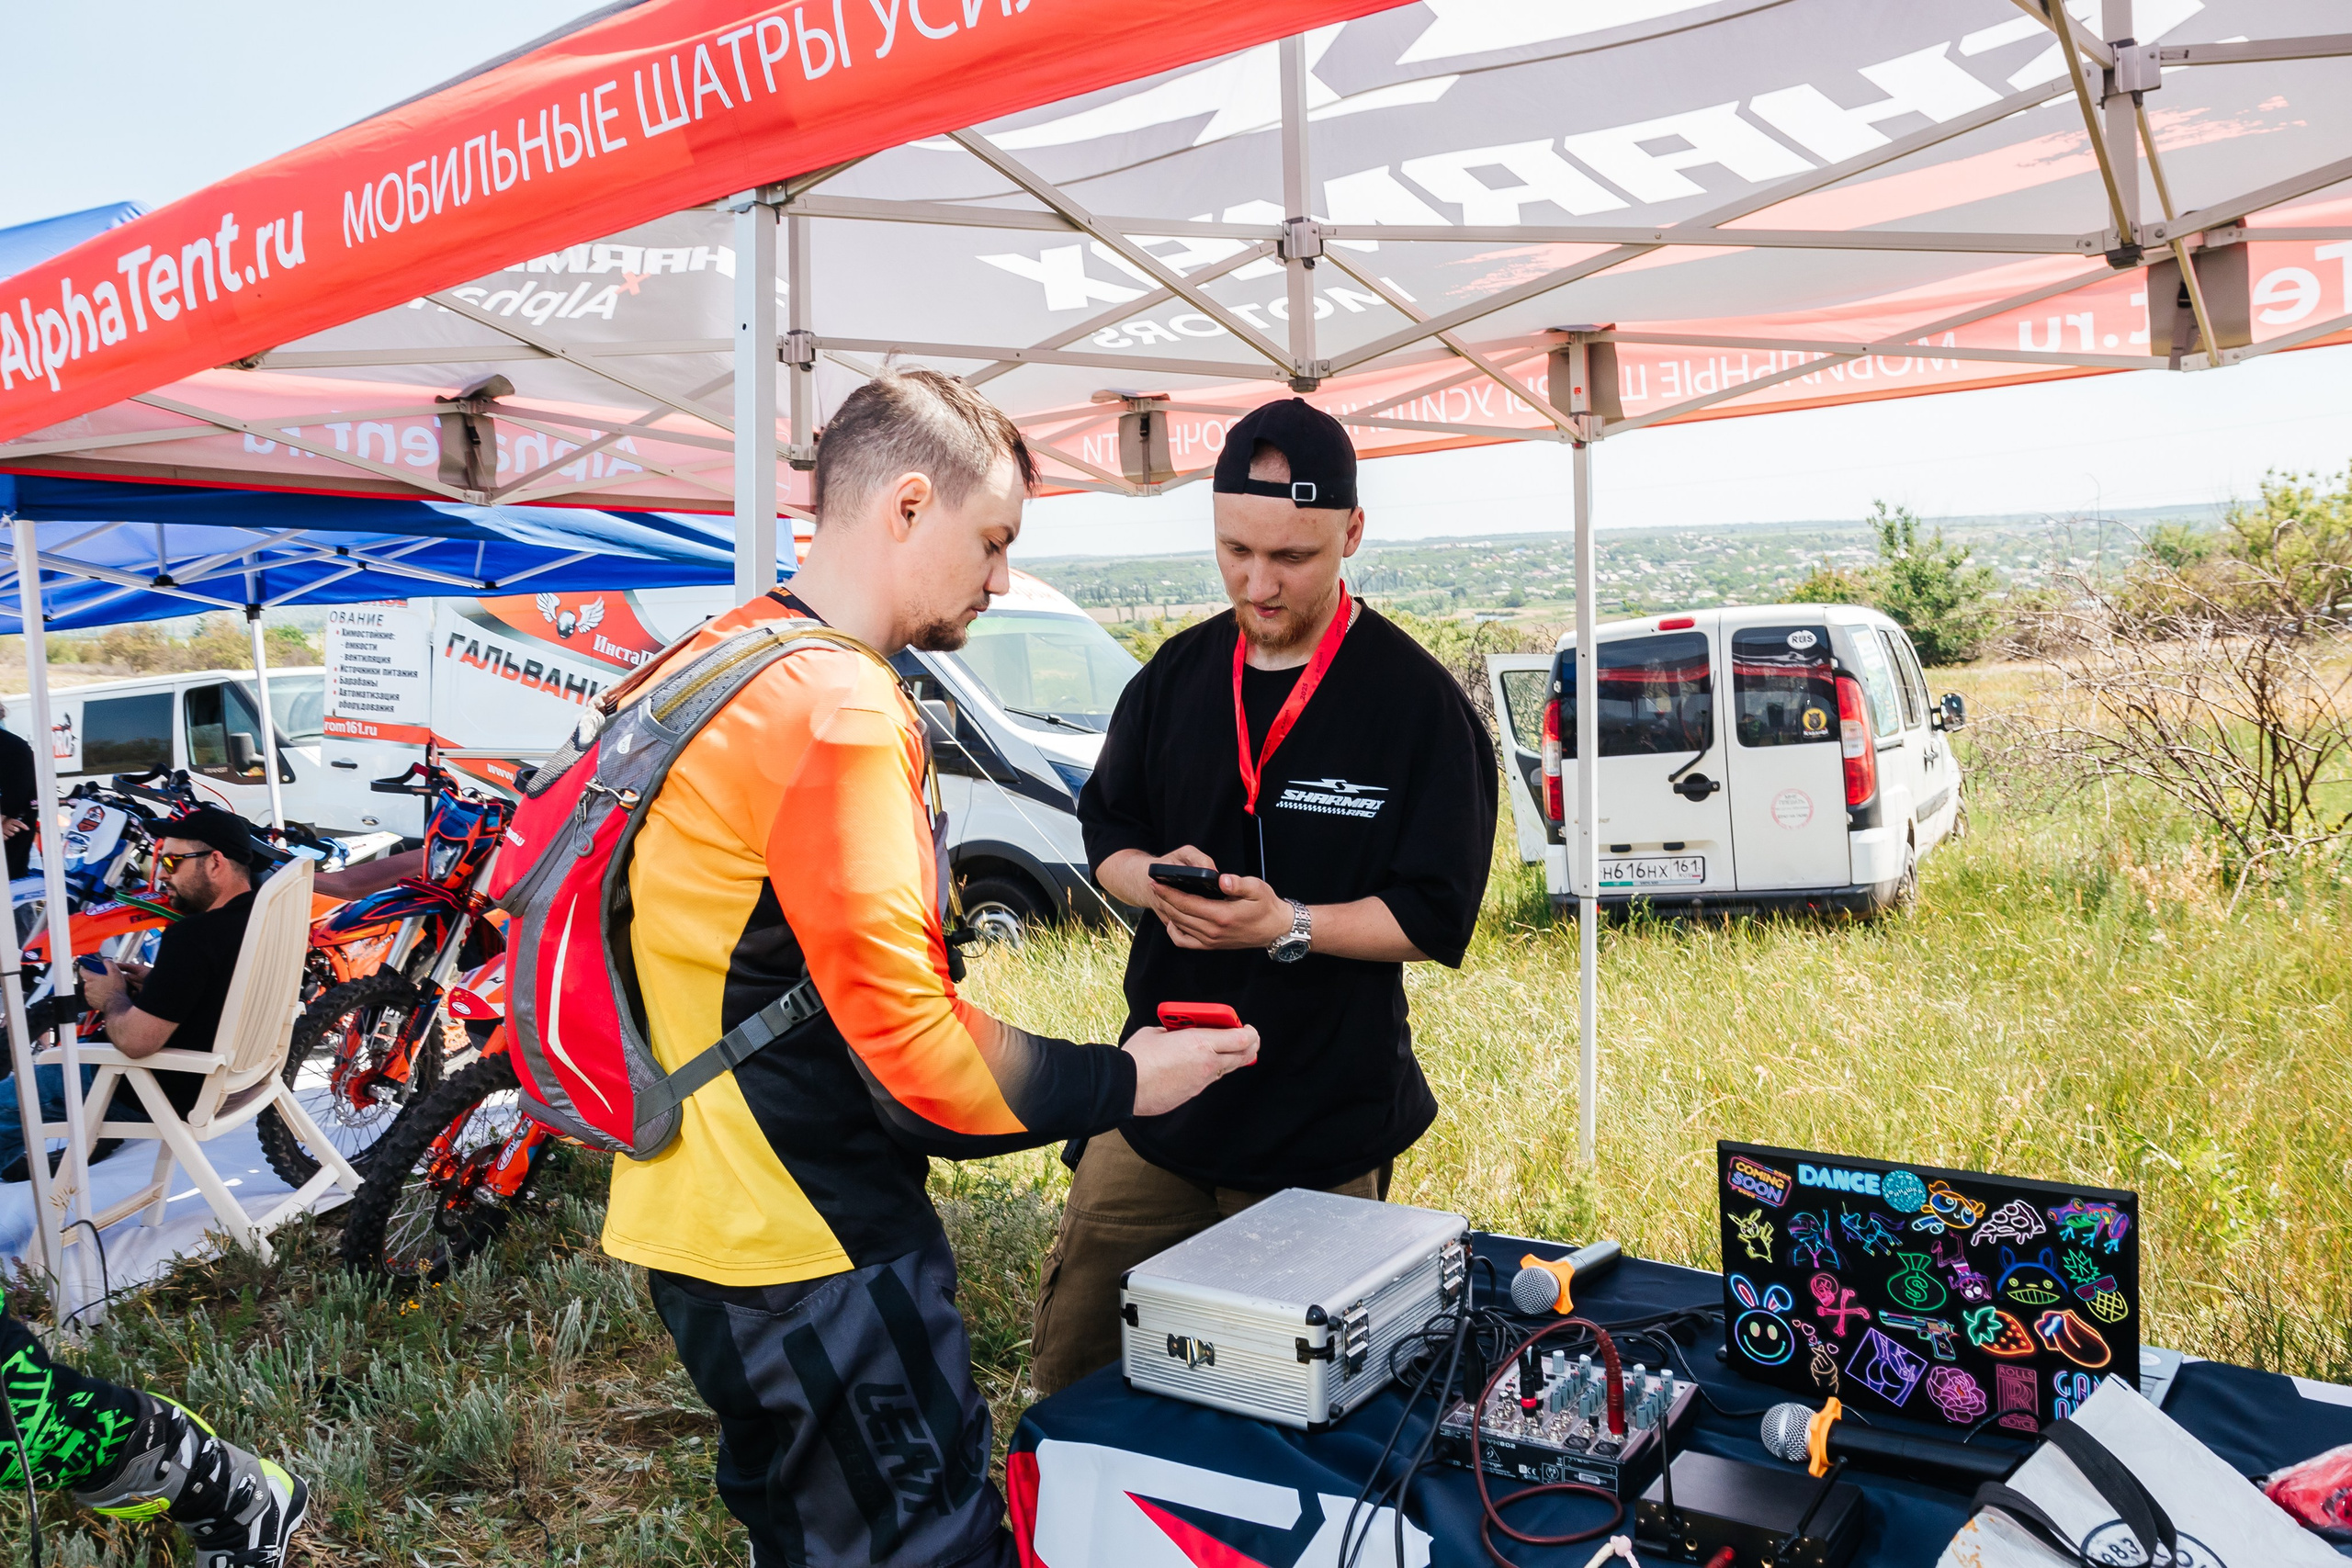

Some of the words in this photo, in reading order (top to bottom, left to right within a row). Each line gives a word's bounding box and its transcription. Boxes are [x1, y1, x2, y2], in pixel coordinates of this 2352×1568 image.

[342, 80, 627, 248] МОБИЛЬНЫЕ
[634, 0, 852, 138] ШАТРЫ
[0, 210, 306, 392] AlphaTent.ru
[329, 610, 384, 627] ОВАНИЕ
[1792, 635, 1814, 644] RUS
[1299, 682, 1308, 701] 2025
[1281, 789, 1385, 810] SHARMAX
[1673, 859, 1698, 873] 161
[1736, 1161, 1785, 1190] COMING
[1798, 1164, 1881, 1195] DANCE
[1732, 1171, 1782, 1202] SOON
[1999, 1367, 2034, 1380] ROLLS
[2001, 1416, 2036, 1430] ROYCE
